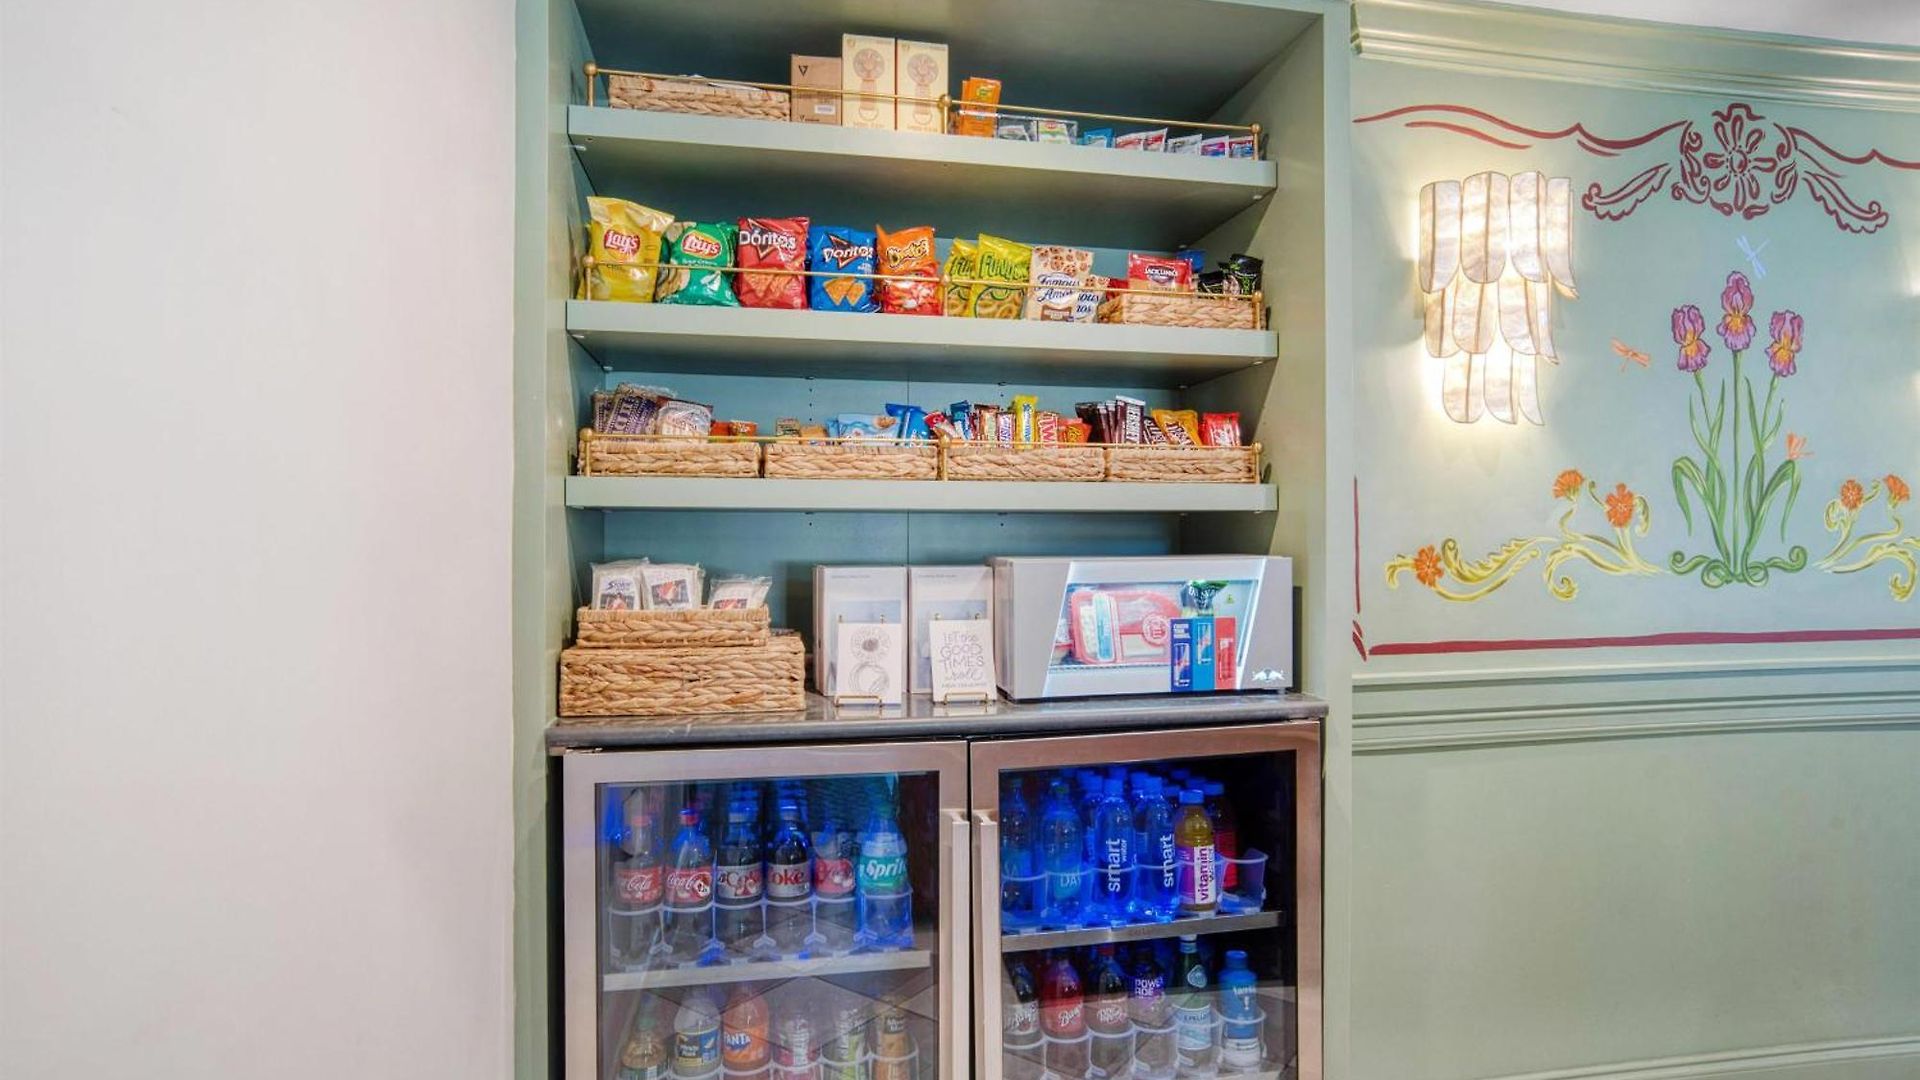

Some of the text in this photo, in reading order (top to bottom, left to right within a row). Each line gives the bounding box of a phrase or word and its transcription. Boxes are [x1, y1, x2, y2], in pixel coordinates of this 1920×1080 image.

[739, 229, 796, 249] Doritos
[823, 246, 873, 263] Doritos
[768, 868, 805, 886] oke
[1106, 838, 1121, 893] smart
[1160, 834, 1175, 888] smart
[1198, 847, 1209, 901] vitamin
